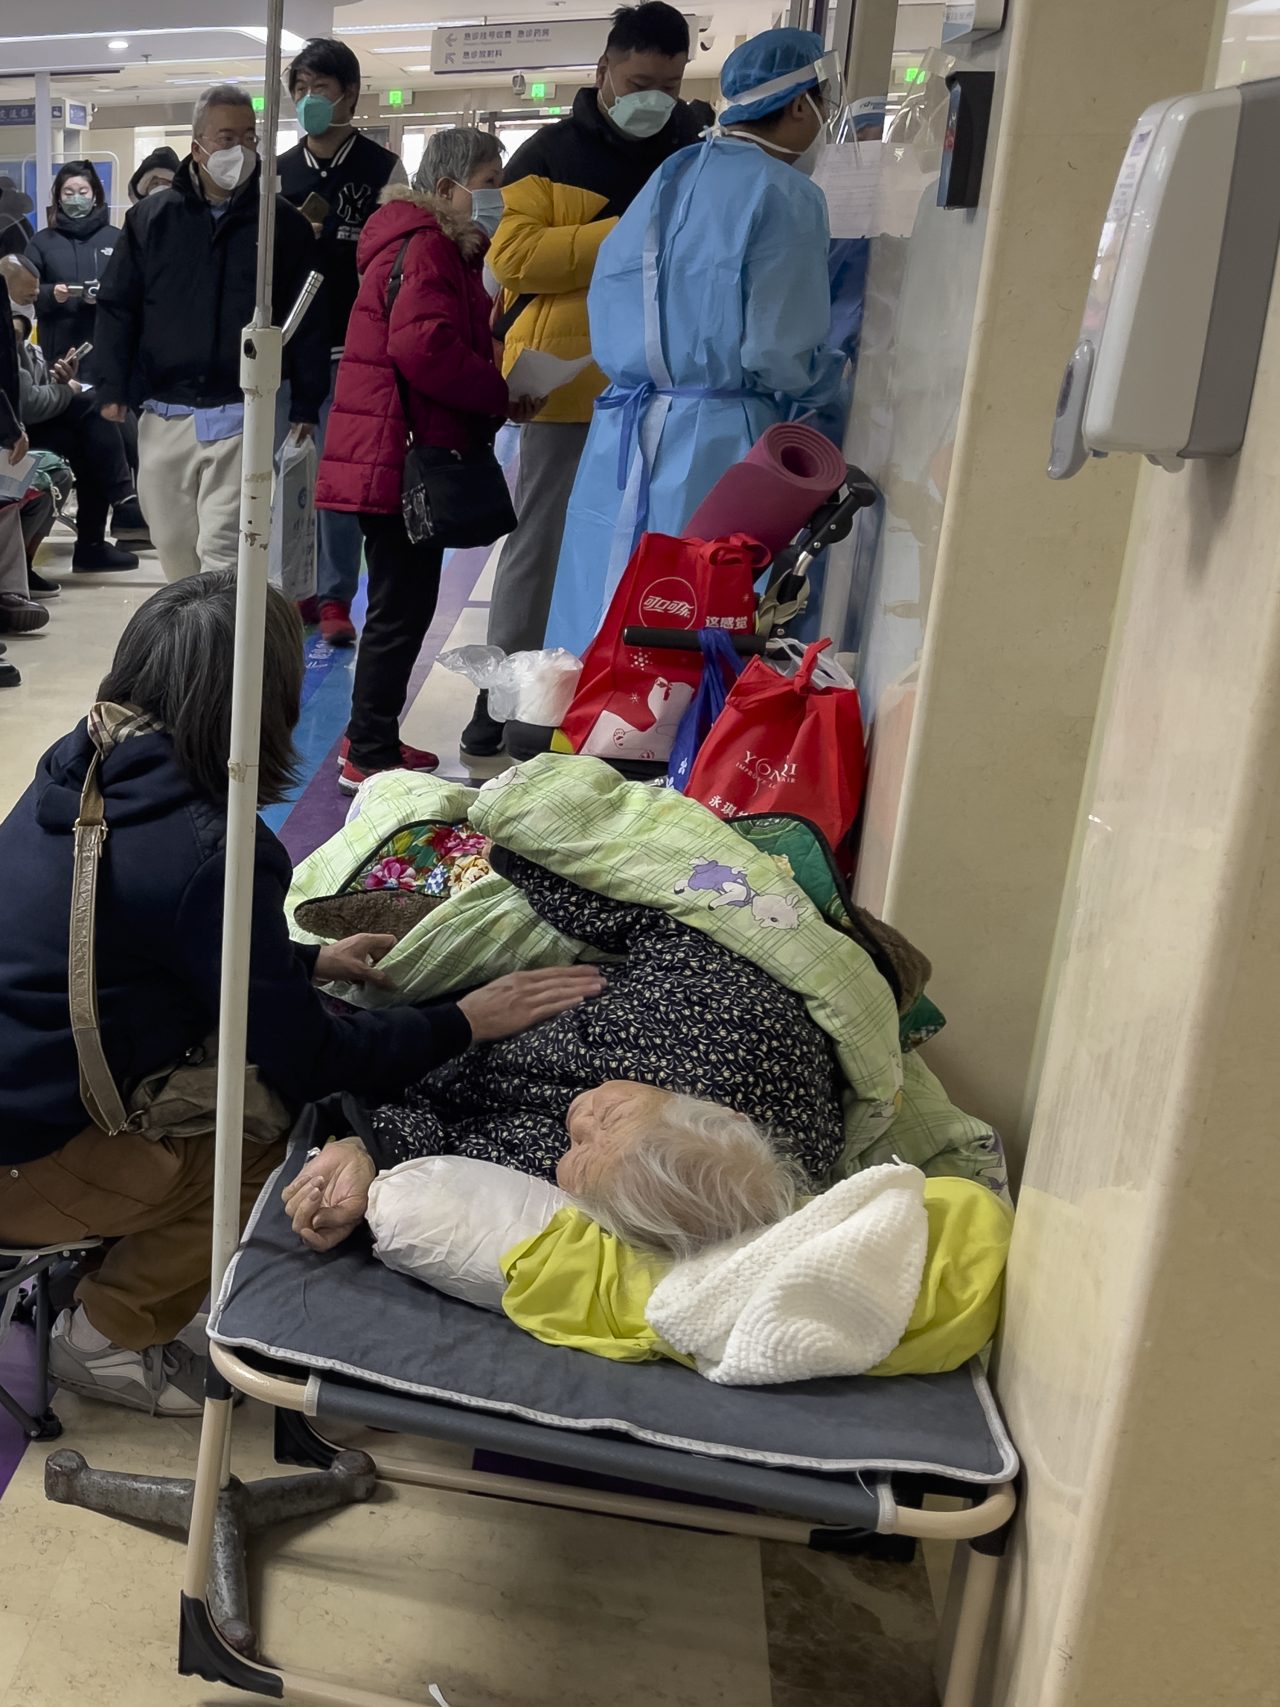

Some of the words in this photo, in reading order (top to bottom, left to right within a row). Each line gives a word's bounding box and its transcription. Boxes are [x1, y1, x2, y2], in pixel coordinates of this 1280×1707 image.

[643, 596, 694, 618] 可口可乐
[705, 616, 748, 629] 这感觉
